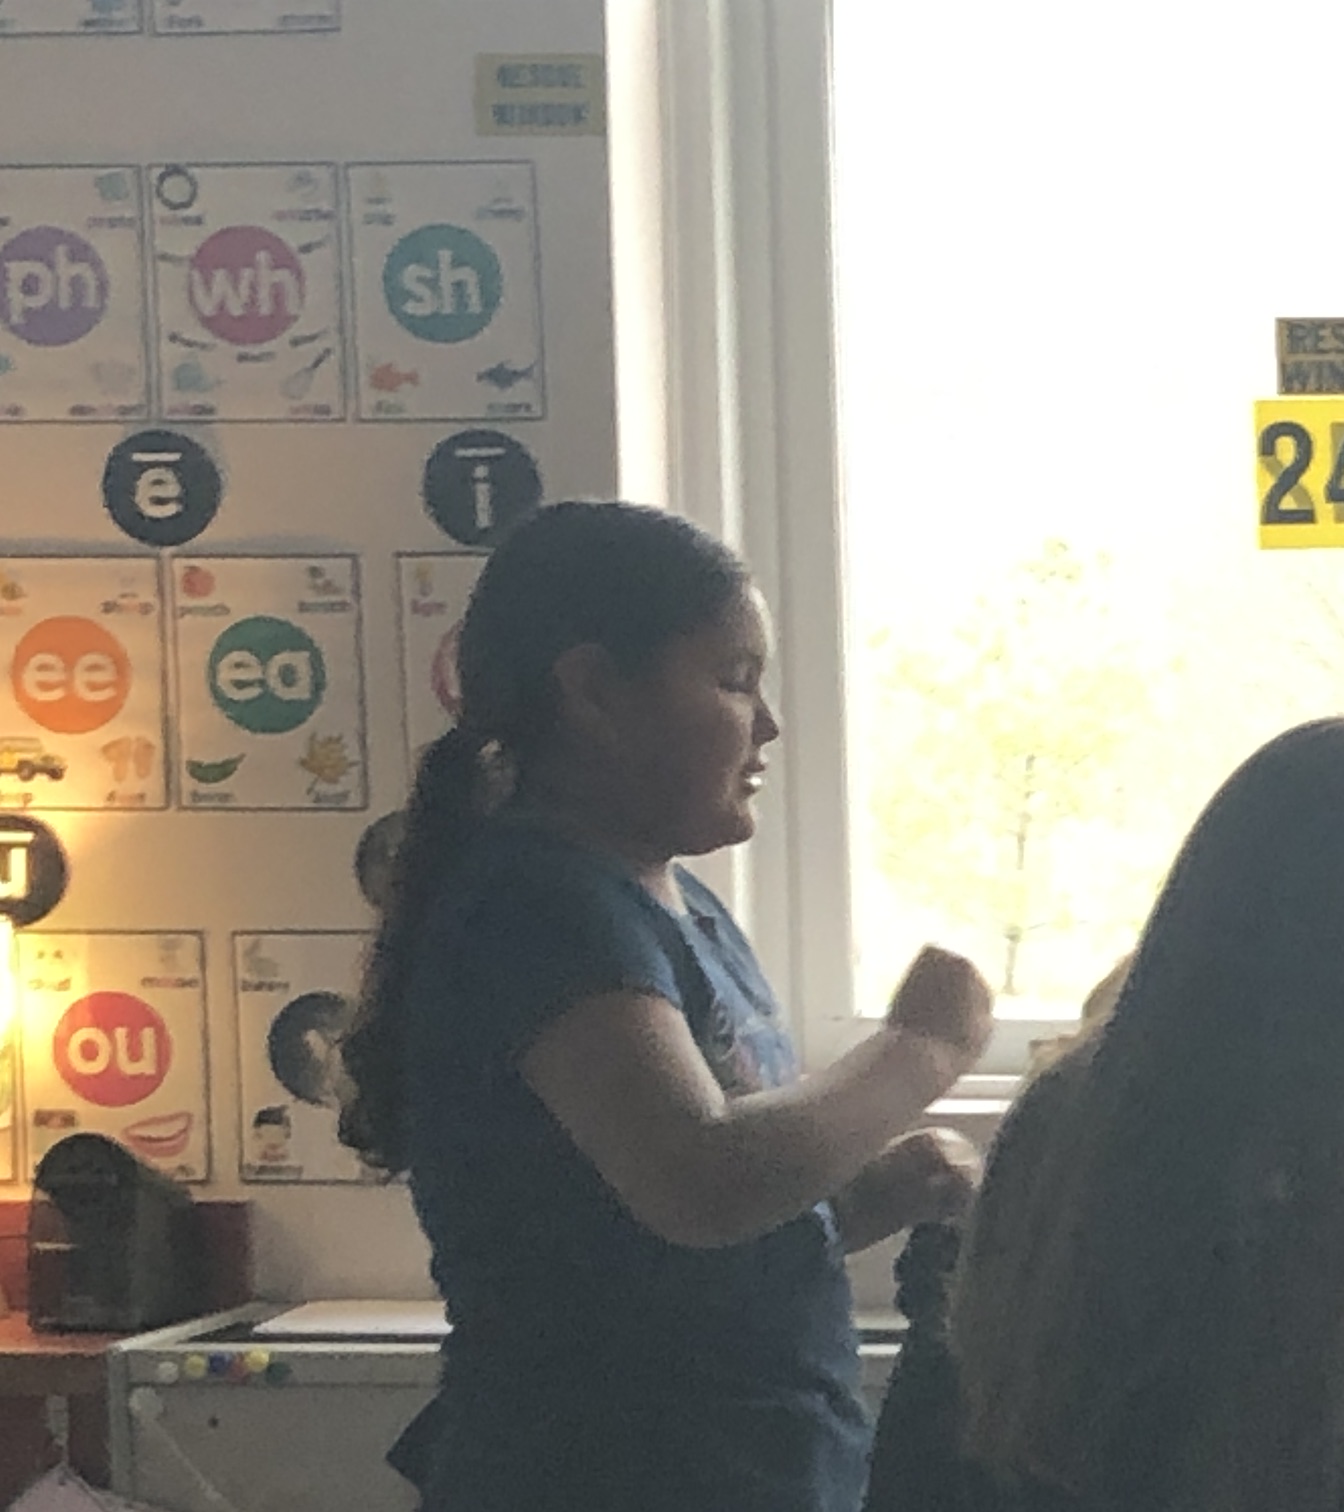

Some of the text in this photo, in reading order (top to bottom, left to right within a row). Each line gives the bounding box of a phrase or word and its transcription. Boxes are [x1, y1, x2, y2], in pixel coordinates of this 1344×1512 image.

[3, 245, 98, 325] ph
[189, 249, 301, 318] wh
[402, 249, 482, 318] sh
[22, 651, 118, 703] ee
[217, 650, 313, 701] ea
[67, 1027, 157, 1076] ou
